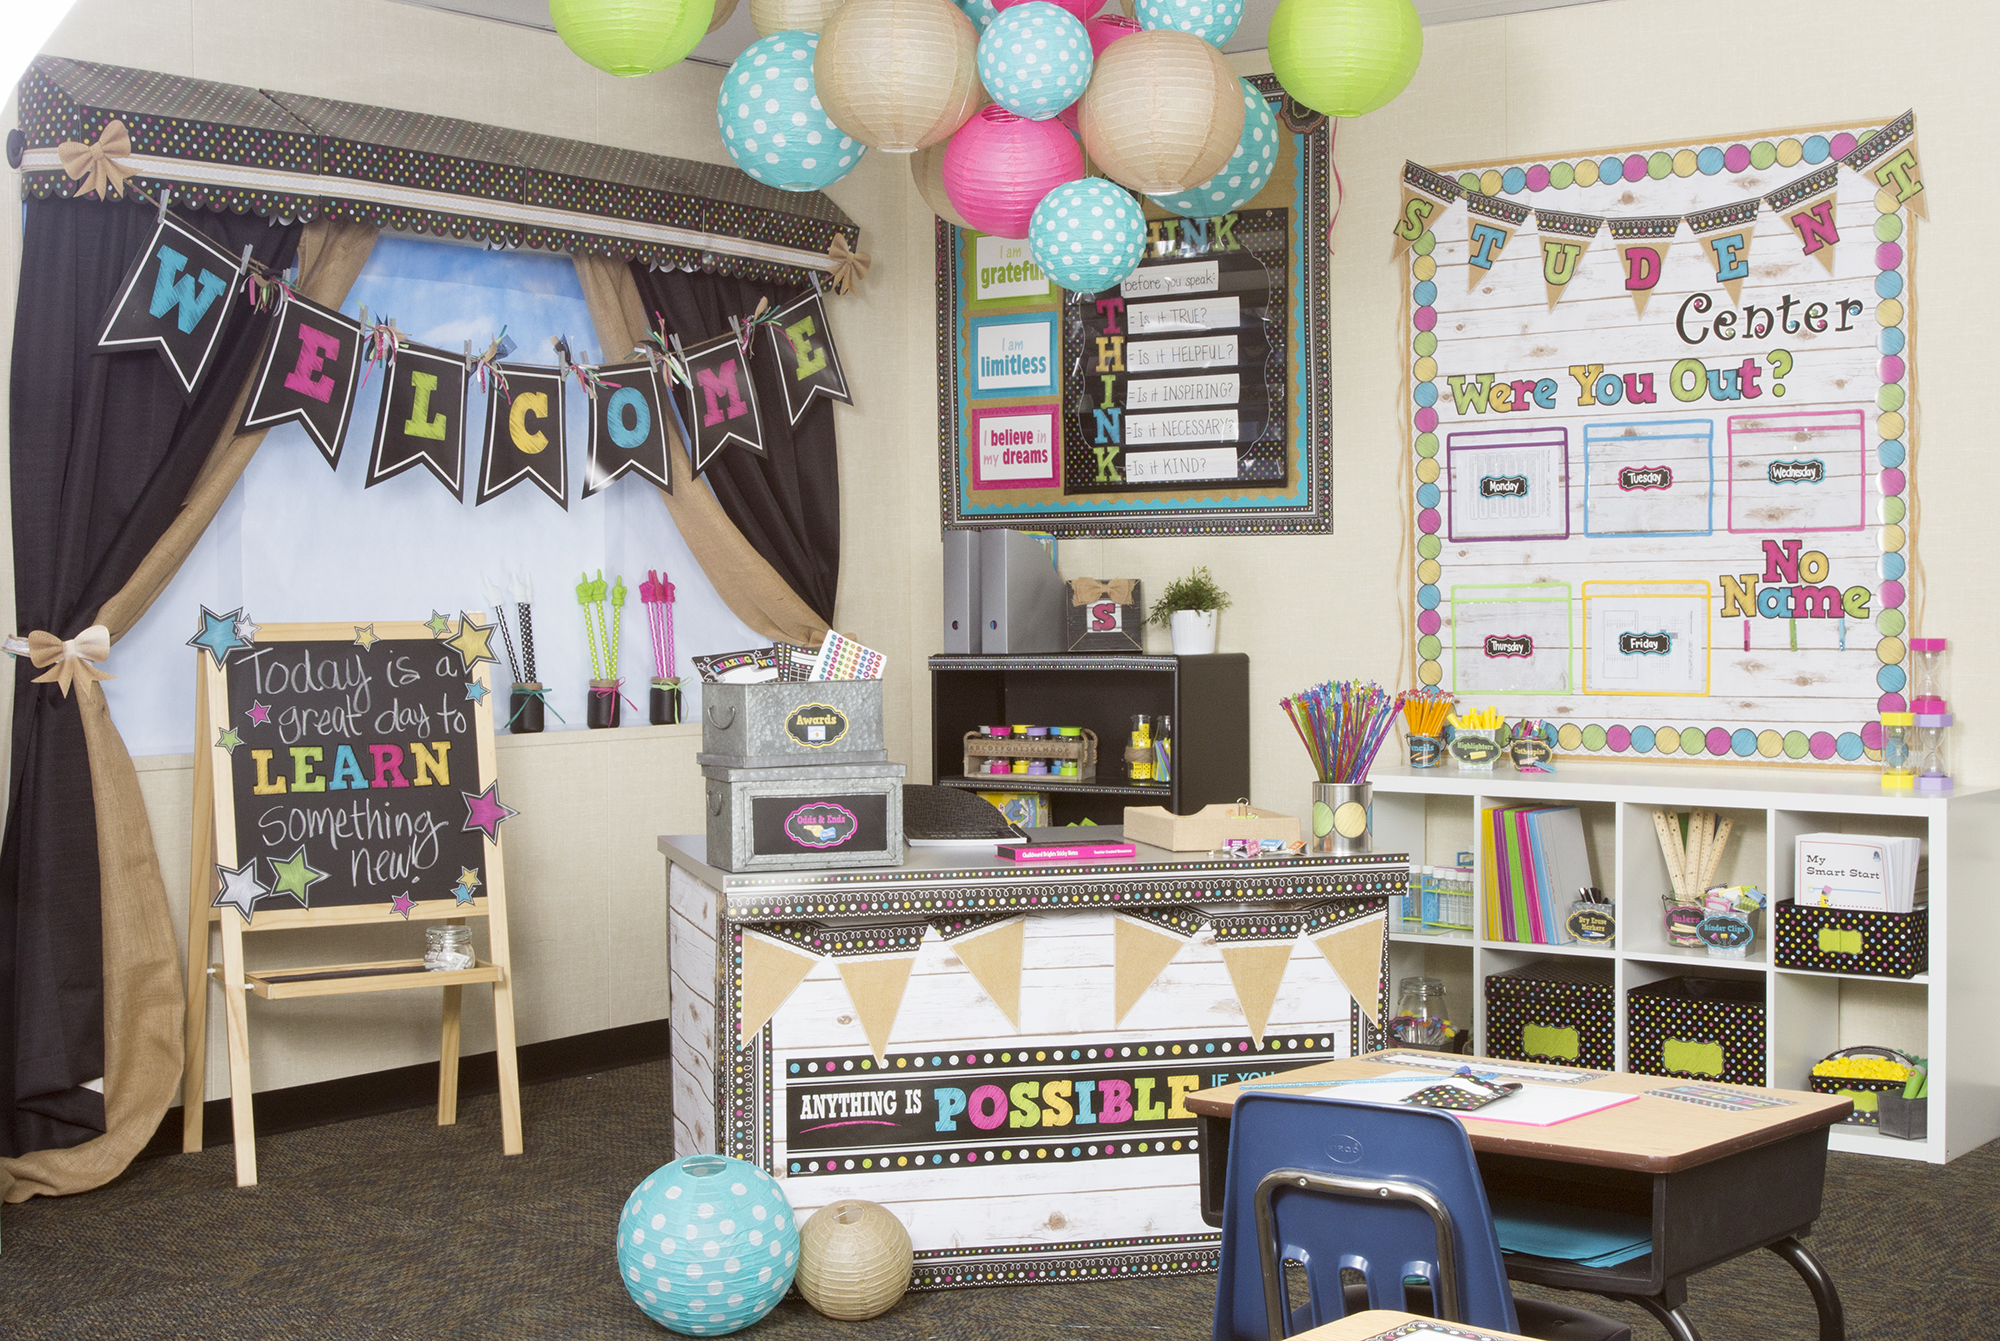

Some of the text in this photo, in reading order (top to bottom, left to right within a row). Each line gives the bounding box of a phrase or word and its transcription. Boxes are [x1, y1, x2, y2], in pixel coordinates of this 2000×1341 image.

[1394, 149, 1924, 291] STUDENT
[1143, 214, 1240, 258] HINK
[1006, 247, 1021, 258] am
[1124, 269, 1216, 292] before you speak:
[1139, 311, 1150, 326] Is
[1172, 307, 1208, 324] TRUE?
[1676, 292, 1864, 346] Center
[149, 244, 827, 455] WELCOME
[1008, 340, 1023, 351] am
[1137, 350, 1150, 365] Is
[1156, 350, 1166, 364] it
[1171, 343, 1235, 363] HELPFUL?
[981, 354, 1047, 377] limitless
[1137, 387, 1148, 402] Is
[1150, 387, 1157, 402] it
[1163, 381, 1234, 401] INSPIRING?
[1448, 349, 1793, 415] Were You Out?
[991, 429, 1033, 446] believe
[1037, 430, 1047, 444] in
[1133, 422, 1143, 438] Is
[1148, 421, 1157, 436] it
[1162, 418, 1235, 437] NECESSARY?
[983, 448, 1048, 467] my dreams
[1134, 460, 1144, 476] Is
[1150, 460, 1159, 475] it
[1163, 457, 1206, 475] KIND?
[1627, 471, 1662, 487] Tuesday
[1772, 464, 1817, 480] Wednesday
[1489, 480, 1520, 493] Monday
[1762, 540, 1830, 583] No
[1720, 574, 1871, 618] Name
[1092, 602, 1116, 631] S
[1491, 639, 1524, 654] Thursday
[1630, 638, 1659, 650] Friday
[713, 656, 753, 673] AMAZING
[234, 647, 458, 713] Today is a
[278, 693, 468, 745] great day to
[796, 714, 837, 726] Awards
[1457, 741, 1494, 751] Highlighters
[250, 740, 452, 796] LEARN
[797, 814, 846, 824] Odds & Ends
[351, 834, 421, 887] new!
[1022, 851, 1043, 859] Chalkboard
[1043, 850, 1056, 858] Brights
[1806, 854, 1827, 865] My
[1806, 866, 1881, 880] Smart Start
[1578, 916, 1607, 926] Dry Erase
[1581, 923, 1606, 932] Markers
[1672, 914, 1700, 923] Rulers
[1704, 924, 1745, 934] Binder Clips
[799, 1089, 898, 1120] ANYTHING
[904, 1088, 922, 1115] IS
[932, 1074, 1199, 1132] POSSIBLE
[1211, 1073, 1230, 1088] IF
